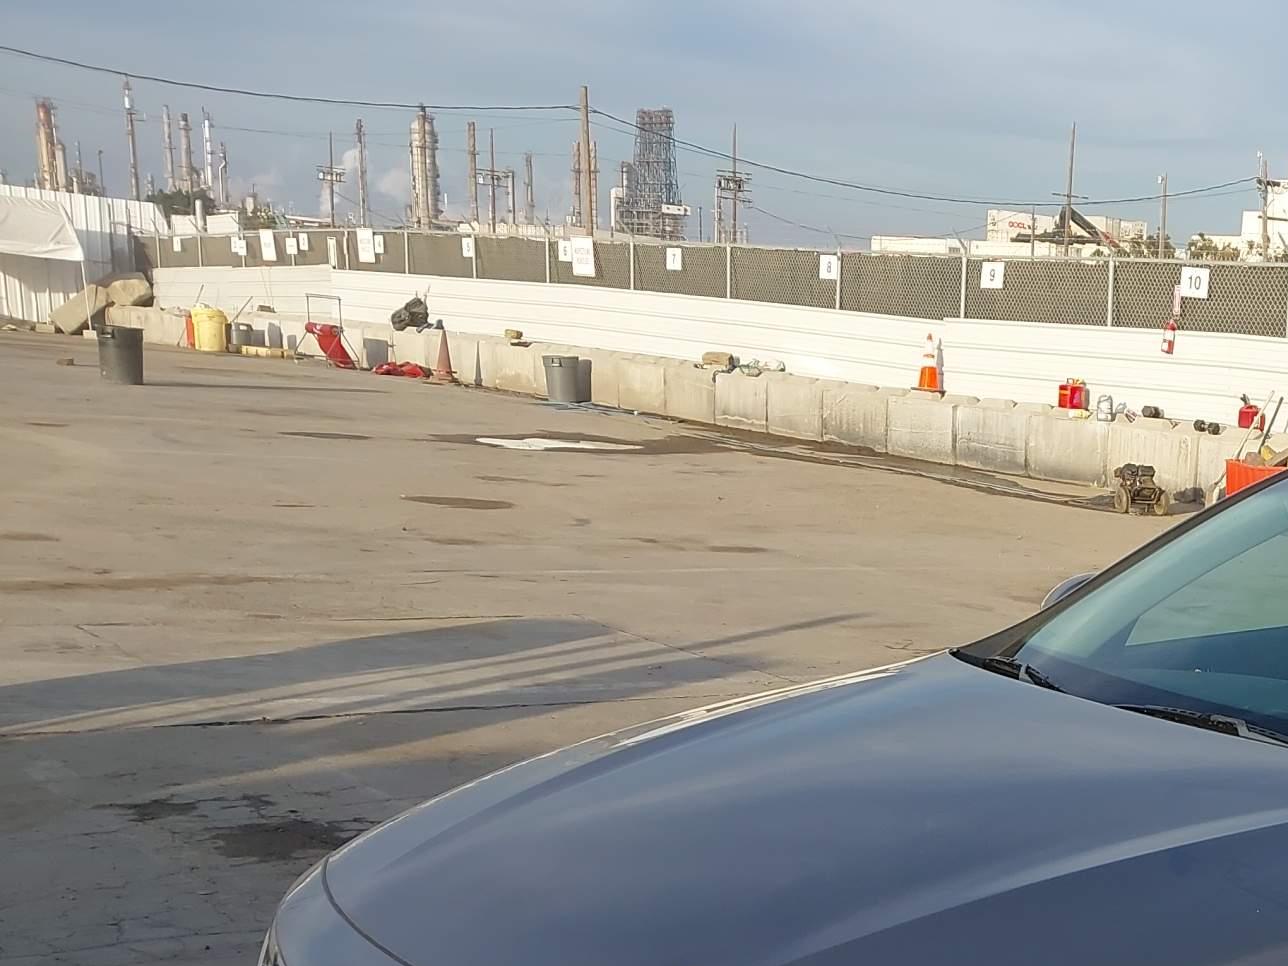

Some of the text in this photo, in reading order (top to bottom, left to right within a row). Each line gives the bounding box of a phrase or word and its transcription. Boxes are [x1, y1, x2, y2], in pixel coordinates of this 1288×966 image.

[672, 253, 677, 265] 7
[826, 260, 832, 274] 8
[989, 268, 996, 282] 9
[1188, 275, 1202, 290] 10
